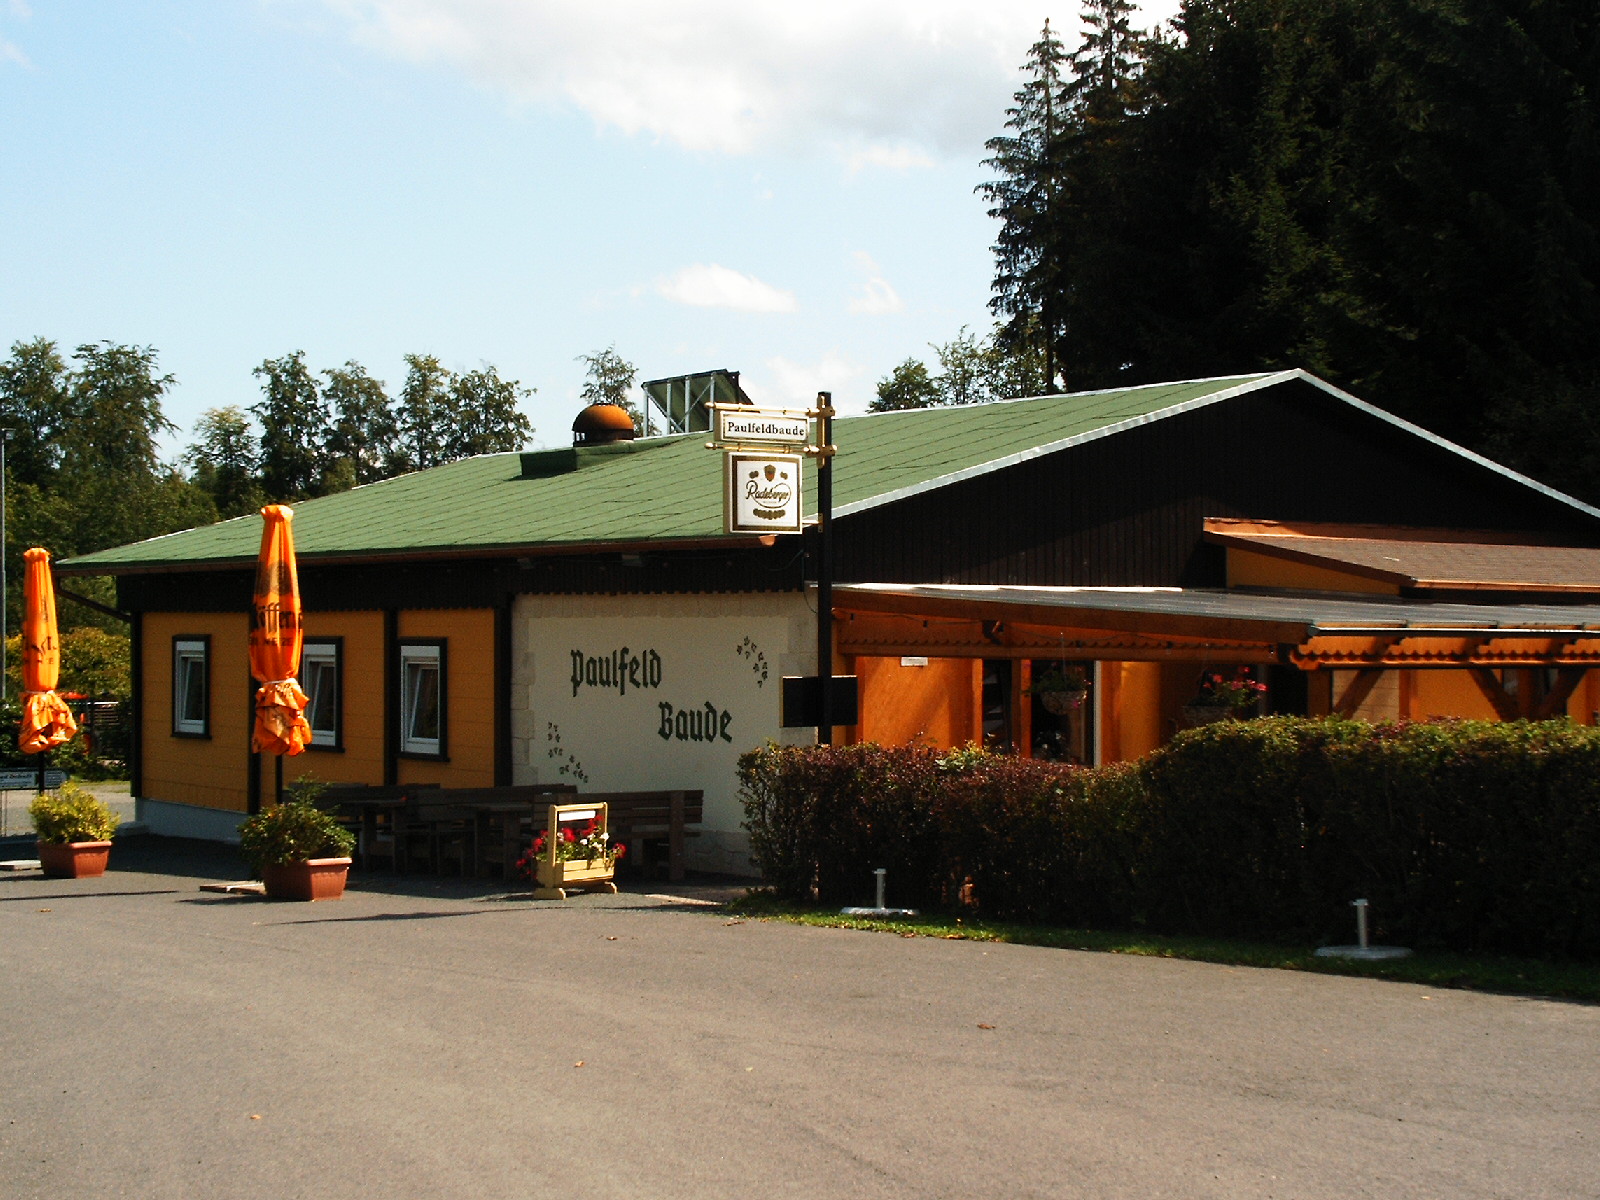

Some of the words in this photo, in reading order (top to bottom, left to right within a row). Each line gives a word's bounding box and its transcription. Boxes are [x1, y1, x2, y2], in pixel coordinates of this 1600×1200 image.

[727, 421, 805, 436] Paulfeldbaude
[745, 480, 790, 504] Radeberger
[570, 646, 662, 697] Paulfeld
[658, 701, 733, 743] Baude
